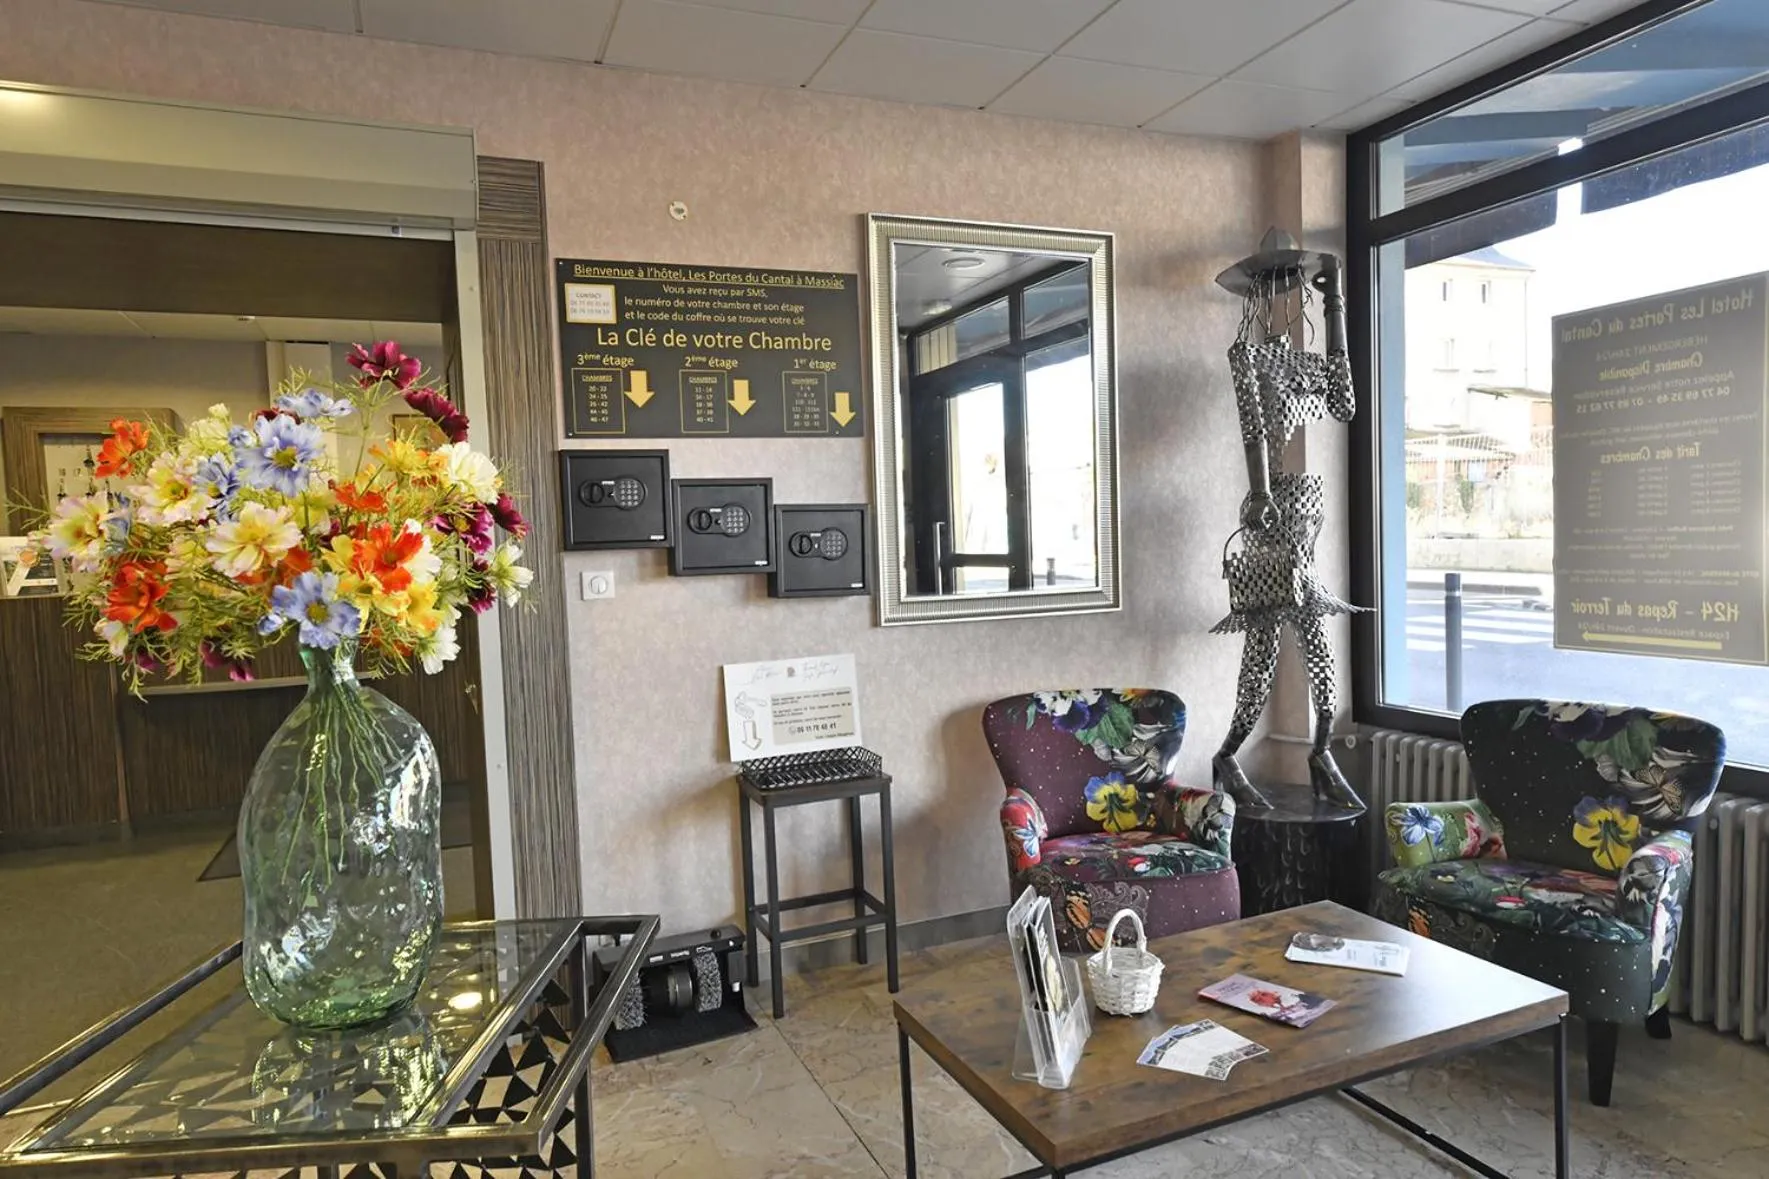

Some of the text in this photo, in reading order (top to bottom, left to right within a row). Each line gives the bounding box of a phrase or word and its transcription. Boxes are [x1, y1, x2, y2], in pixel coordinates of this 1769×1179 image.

[574, 264, 636, 277] Bienvenue
[638, 267, 645, 278] à
[688, 270, 706, 281] Les
[708, 271, 742, 283] Portes
[745, 273, 759, 283] du
[761, 274, 794, 285] Cantal
[804, 276, 846, 290] Massiac
[662, 284, 685, 295] Vous
[687, 287, 707, 295] avez
[709, 288, 729, 297] reçu
[730, 289, 744, 298] par
[624, 296, 805, 314] le numéro de votre chambre et son étage
[624, 310, 634, 319] et
[636, 310, 645, 319] le
[646, 311, 671, 321] code
[674, 312, 685, 321] du
[685, 312, 712, 322] coffre
[726, 315, 738, 323] se
[739, 315, 768, 324] trouve
[769, 316, 792, 325] votre
[597, 327, 833, 352] La Clé de votre Chambre
[602, 354, 635, 369] étage
[708, 357, 739, 370] étage
[808, 359, 838, 372] étage
